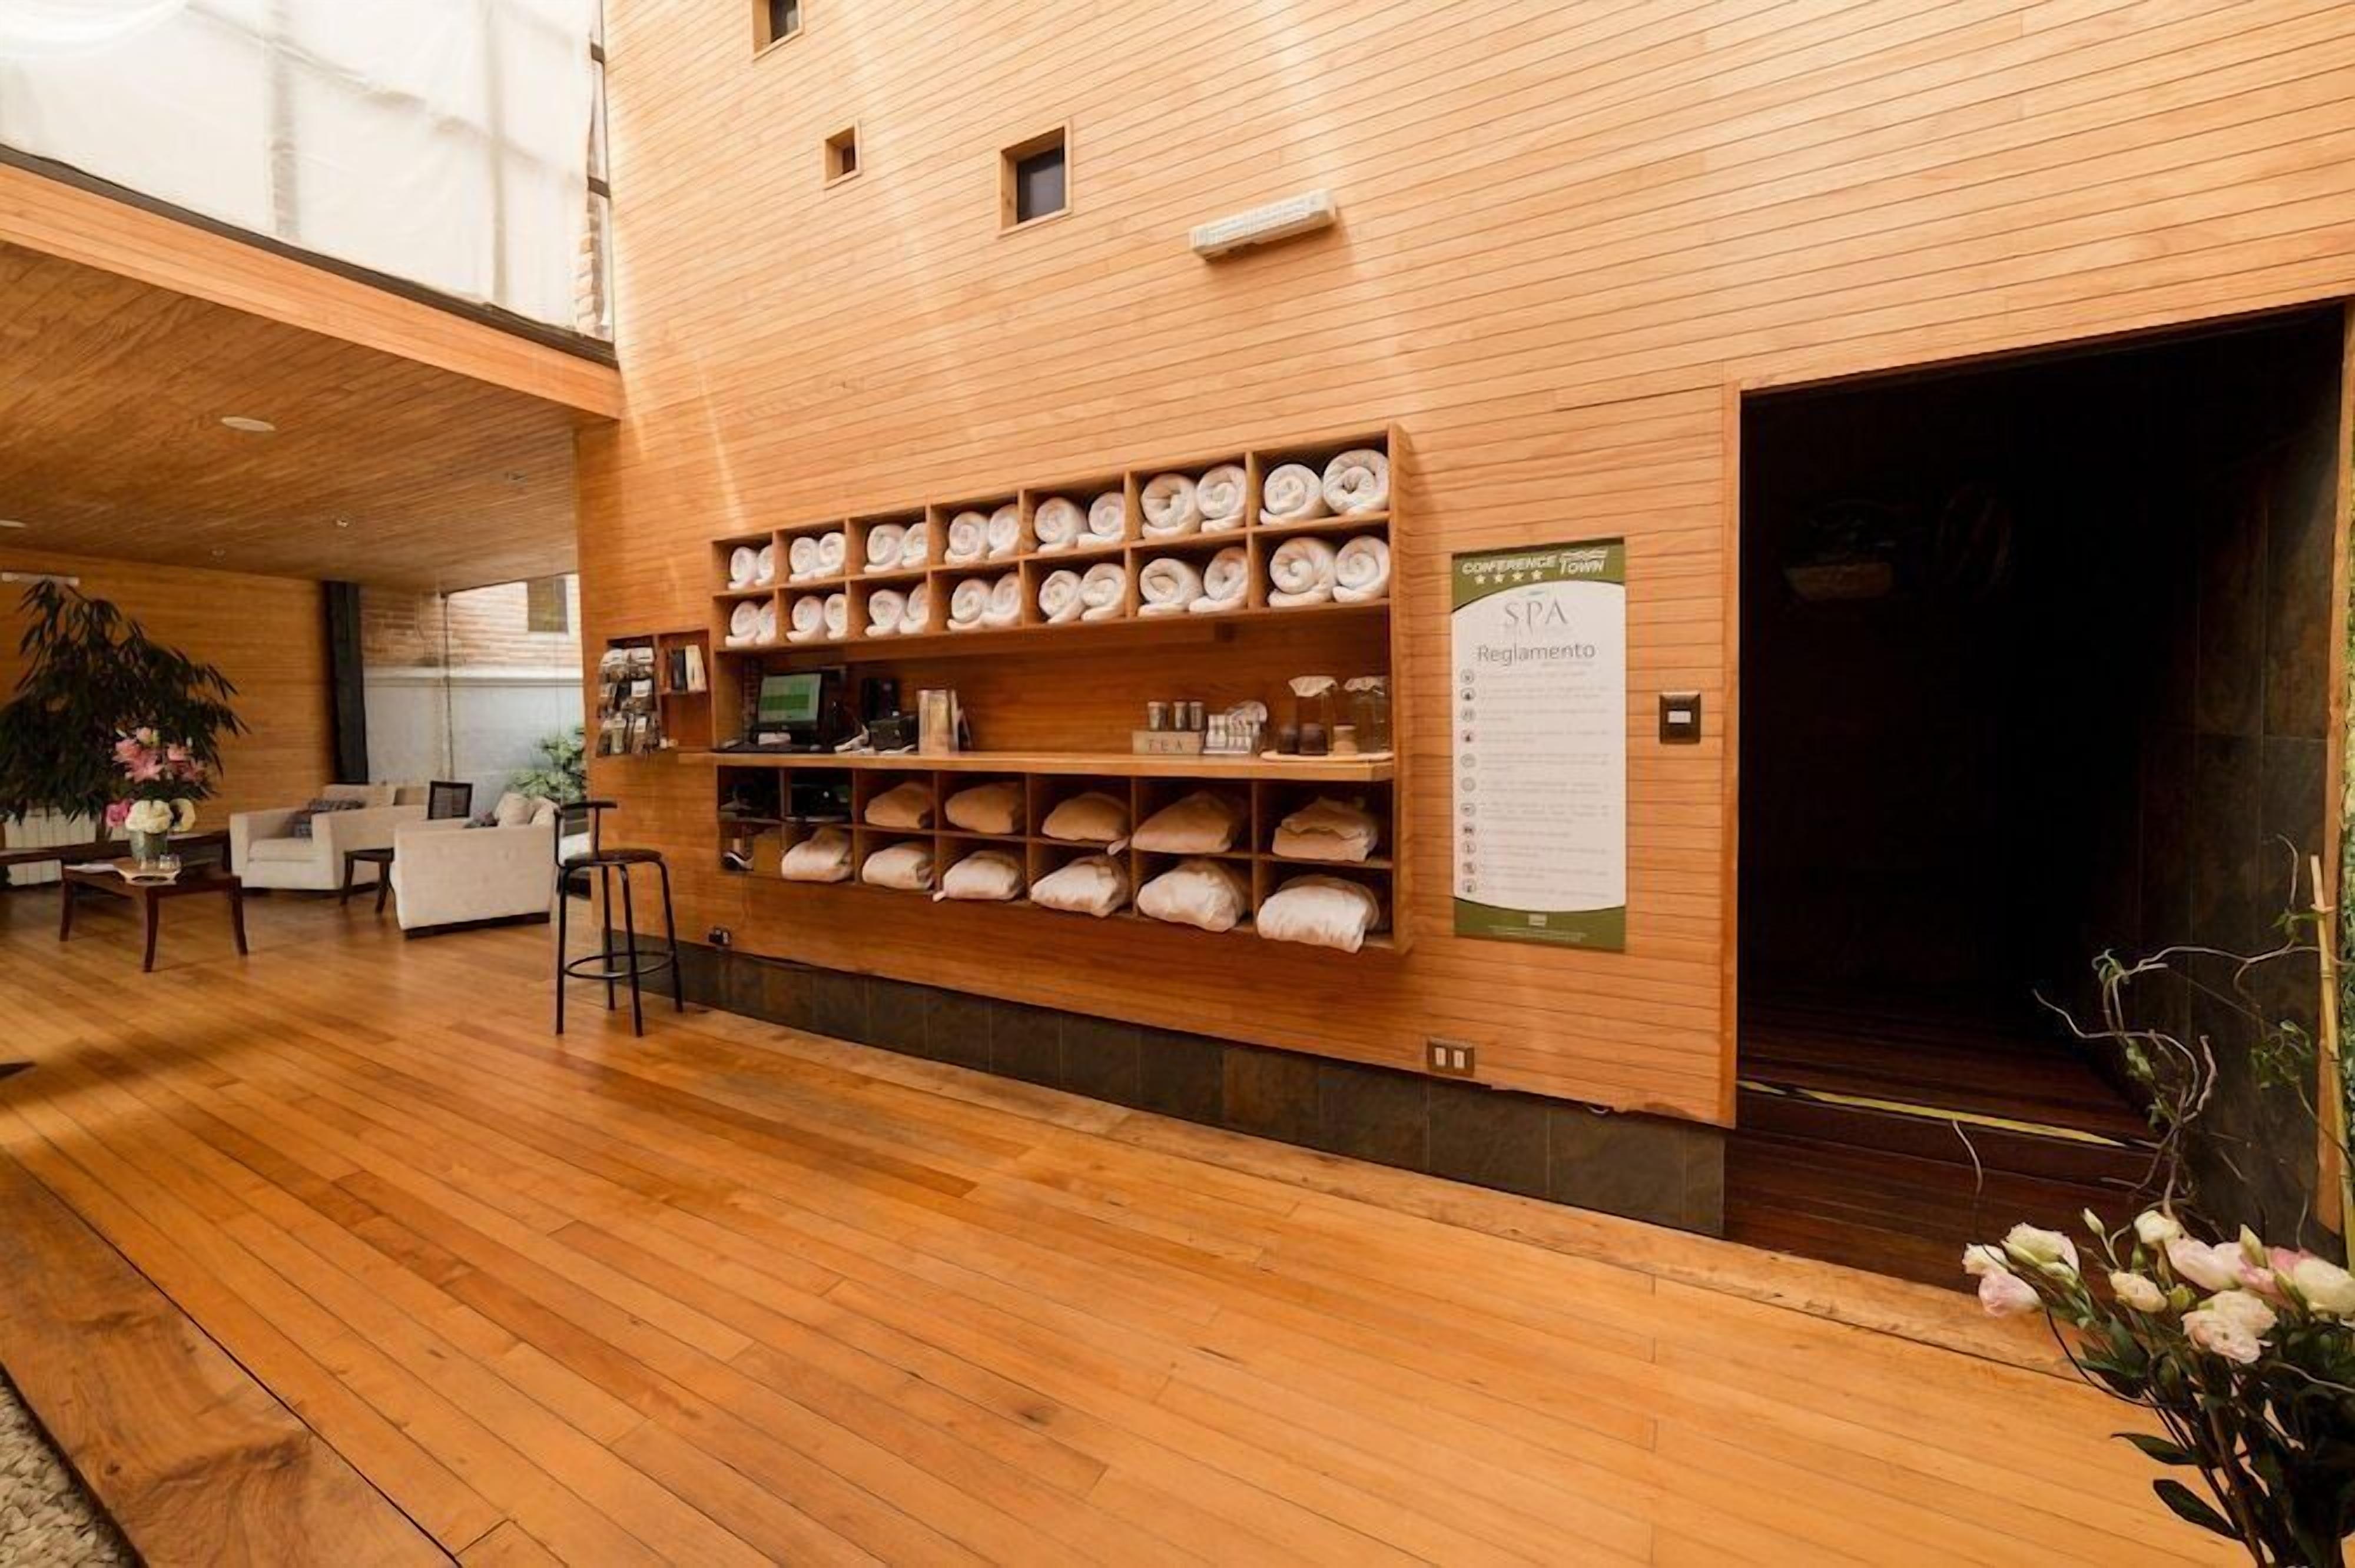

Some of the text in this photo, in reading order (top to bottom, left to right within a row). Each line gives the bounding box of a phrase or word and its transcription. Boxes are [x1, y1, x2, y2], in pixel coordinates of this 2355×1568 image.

[1504, 597, 1569, 635] SPA
[1477, 643, 1596, 666] Reglamento
[1148, 739, 1183, 752] TEA
